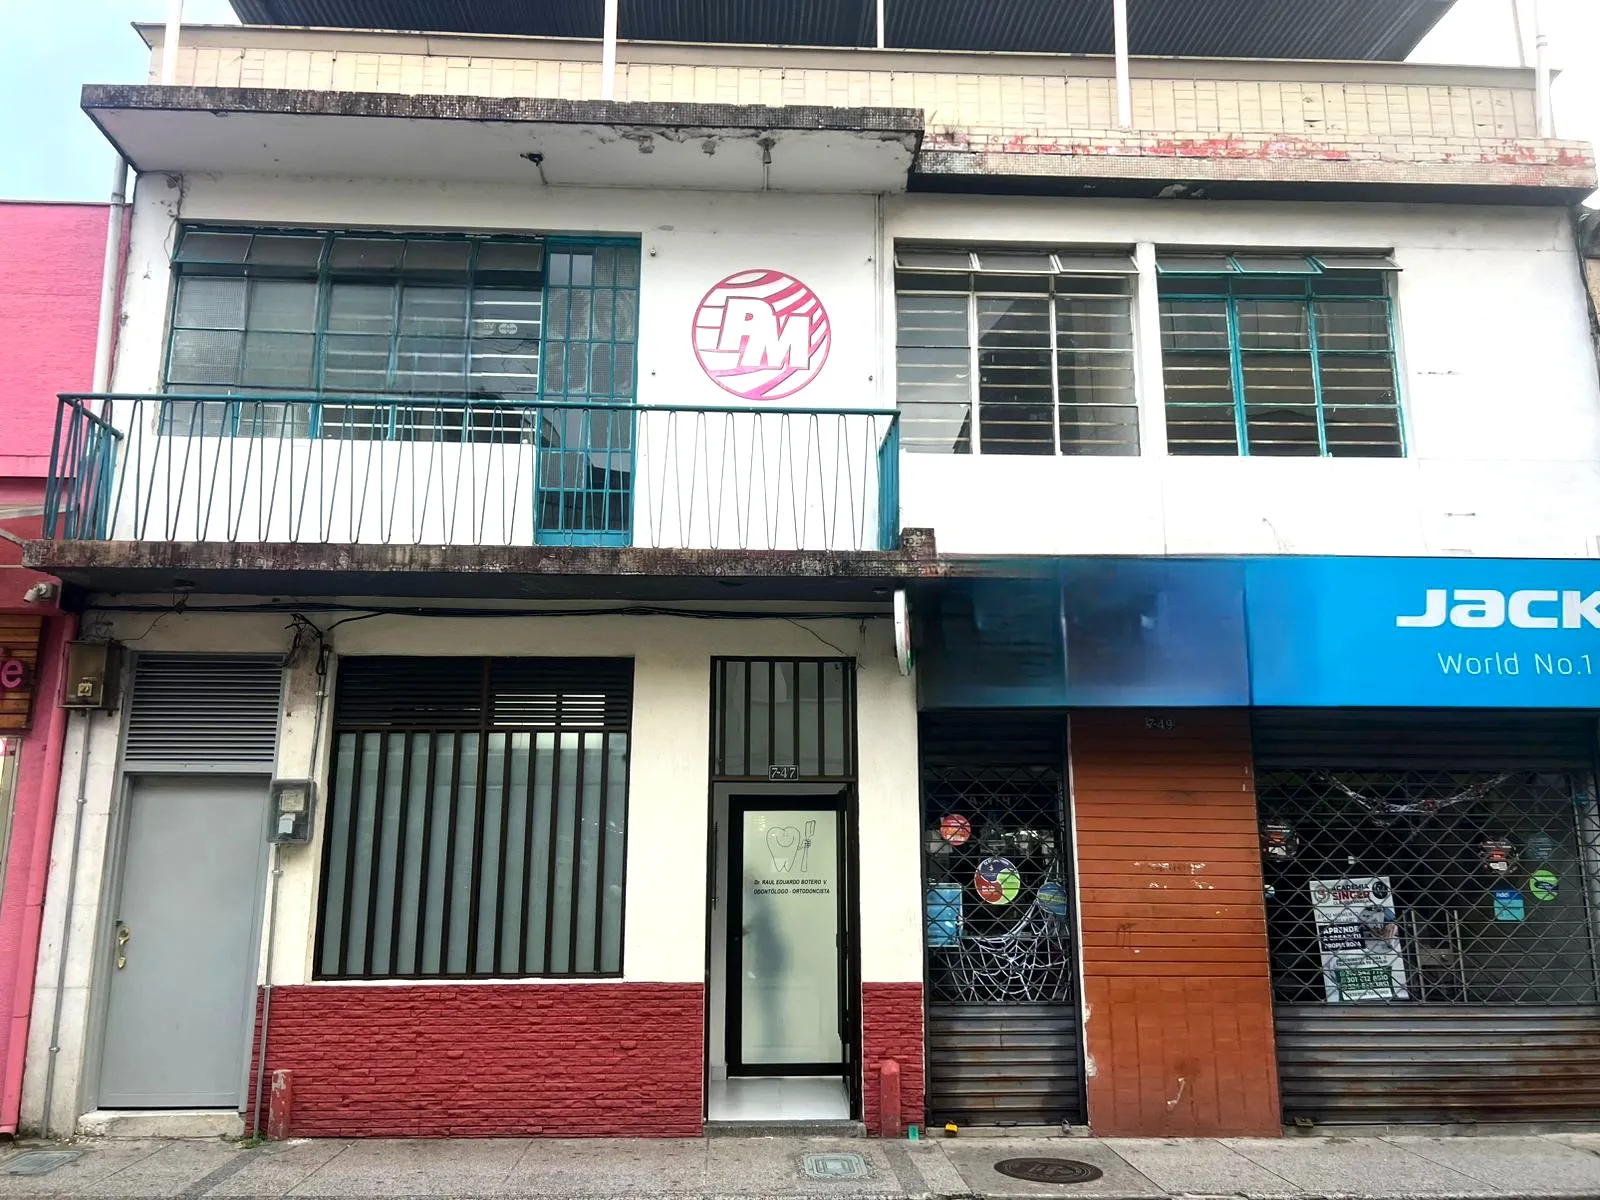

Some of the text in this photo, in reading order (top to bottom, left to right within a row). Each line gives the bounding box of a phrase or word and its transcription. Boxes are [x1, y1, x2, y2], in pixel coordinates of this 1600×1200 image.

[1438, 652, 1592, 676] World No.1
[771, 767, 796, 779] 7-47
[1332, 891, 1370, 900] SINGER
[1323, 926, 1359, 934] APRENDE
